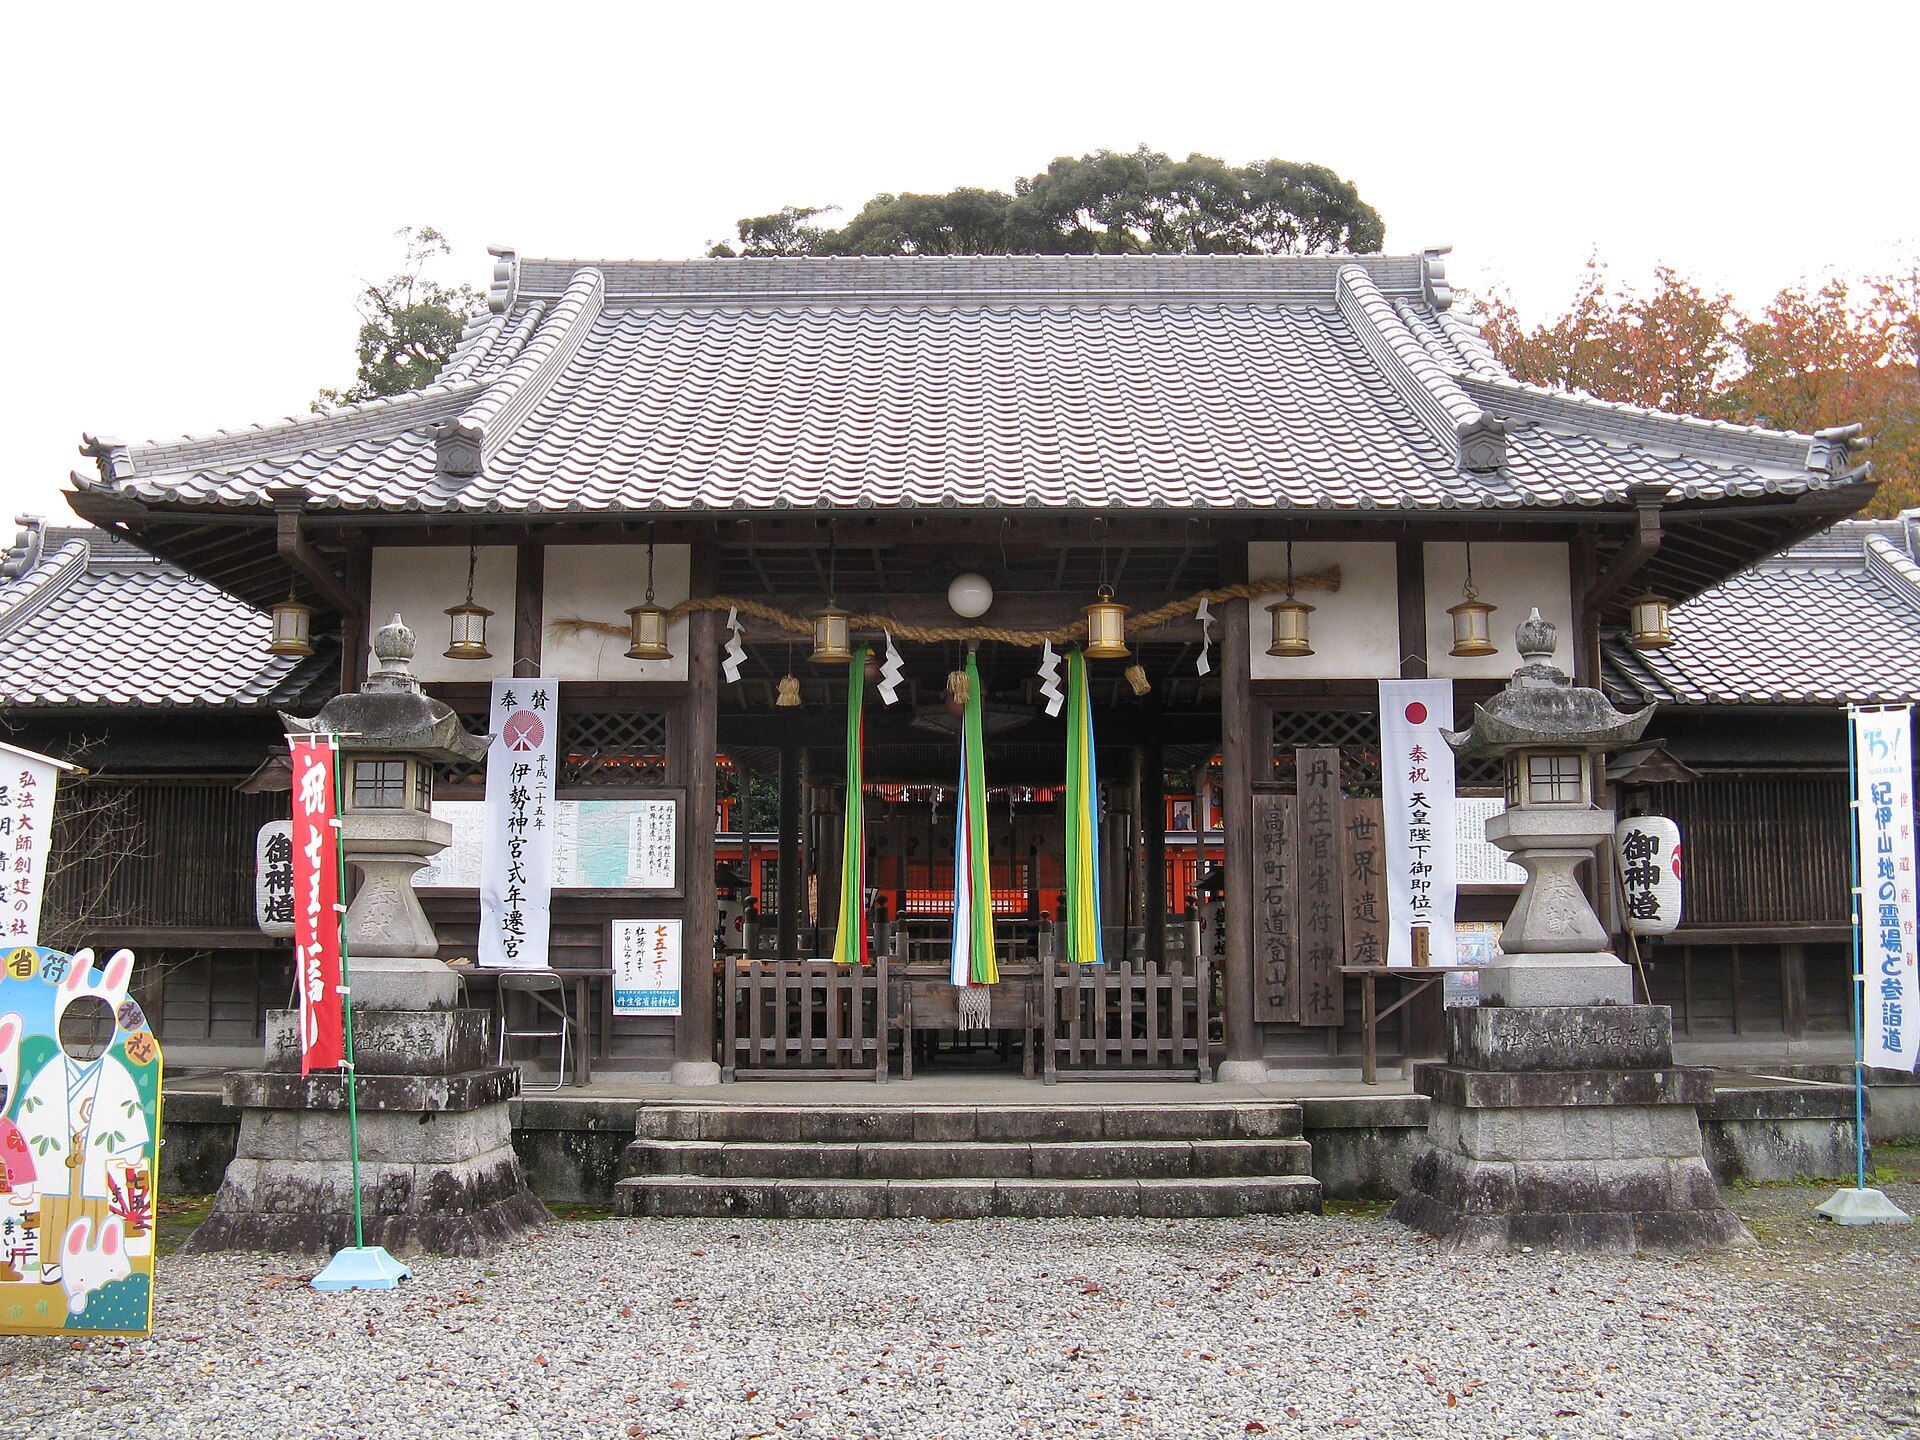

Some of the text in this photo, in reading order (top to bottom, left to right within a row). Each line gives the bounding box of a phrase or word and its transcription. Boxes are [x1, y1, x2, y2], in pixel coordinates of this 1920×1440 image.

[500, 689, 550, 712] 奉賛
[1408, 744, 1429, 783] 奉祝
[10, 771, 37, 936] 弘法大師創建の社
[502, 762, 532, 958] 伊勢神宮式年遷宮
[533, 754, 548, 831] 平成二十五年
[652, 924, 668, 989] 七五三まいり
[1262, 807, 1288, 1008] 高野町石道登山口
[1305, 760, 1336, 1014] 丹生官省符神社
[1347, 814, 1379, 965] 世界遺産
[1871, 781, 1904, 1054] 紀伊山地の霊場と参詣道
[1899, 793, 1914, 966] 世界遺産登録
[20, 1210, 38, 1256] 七五三
